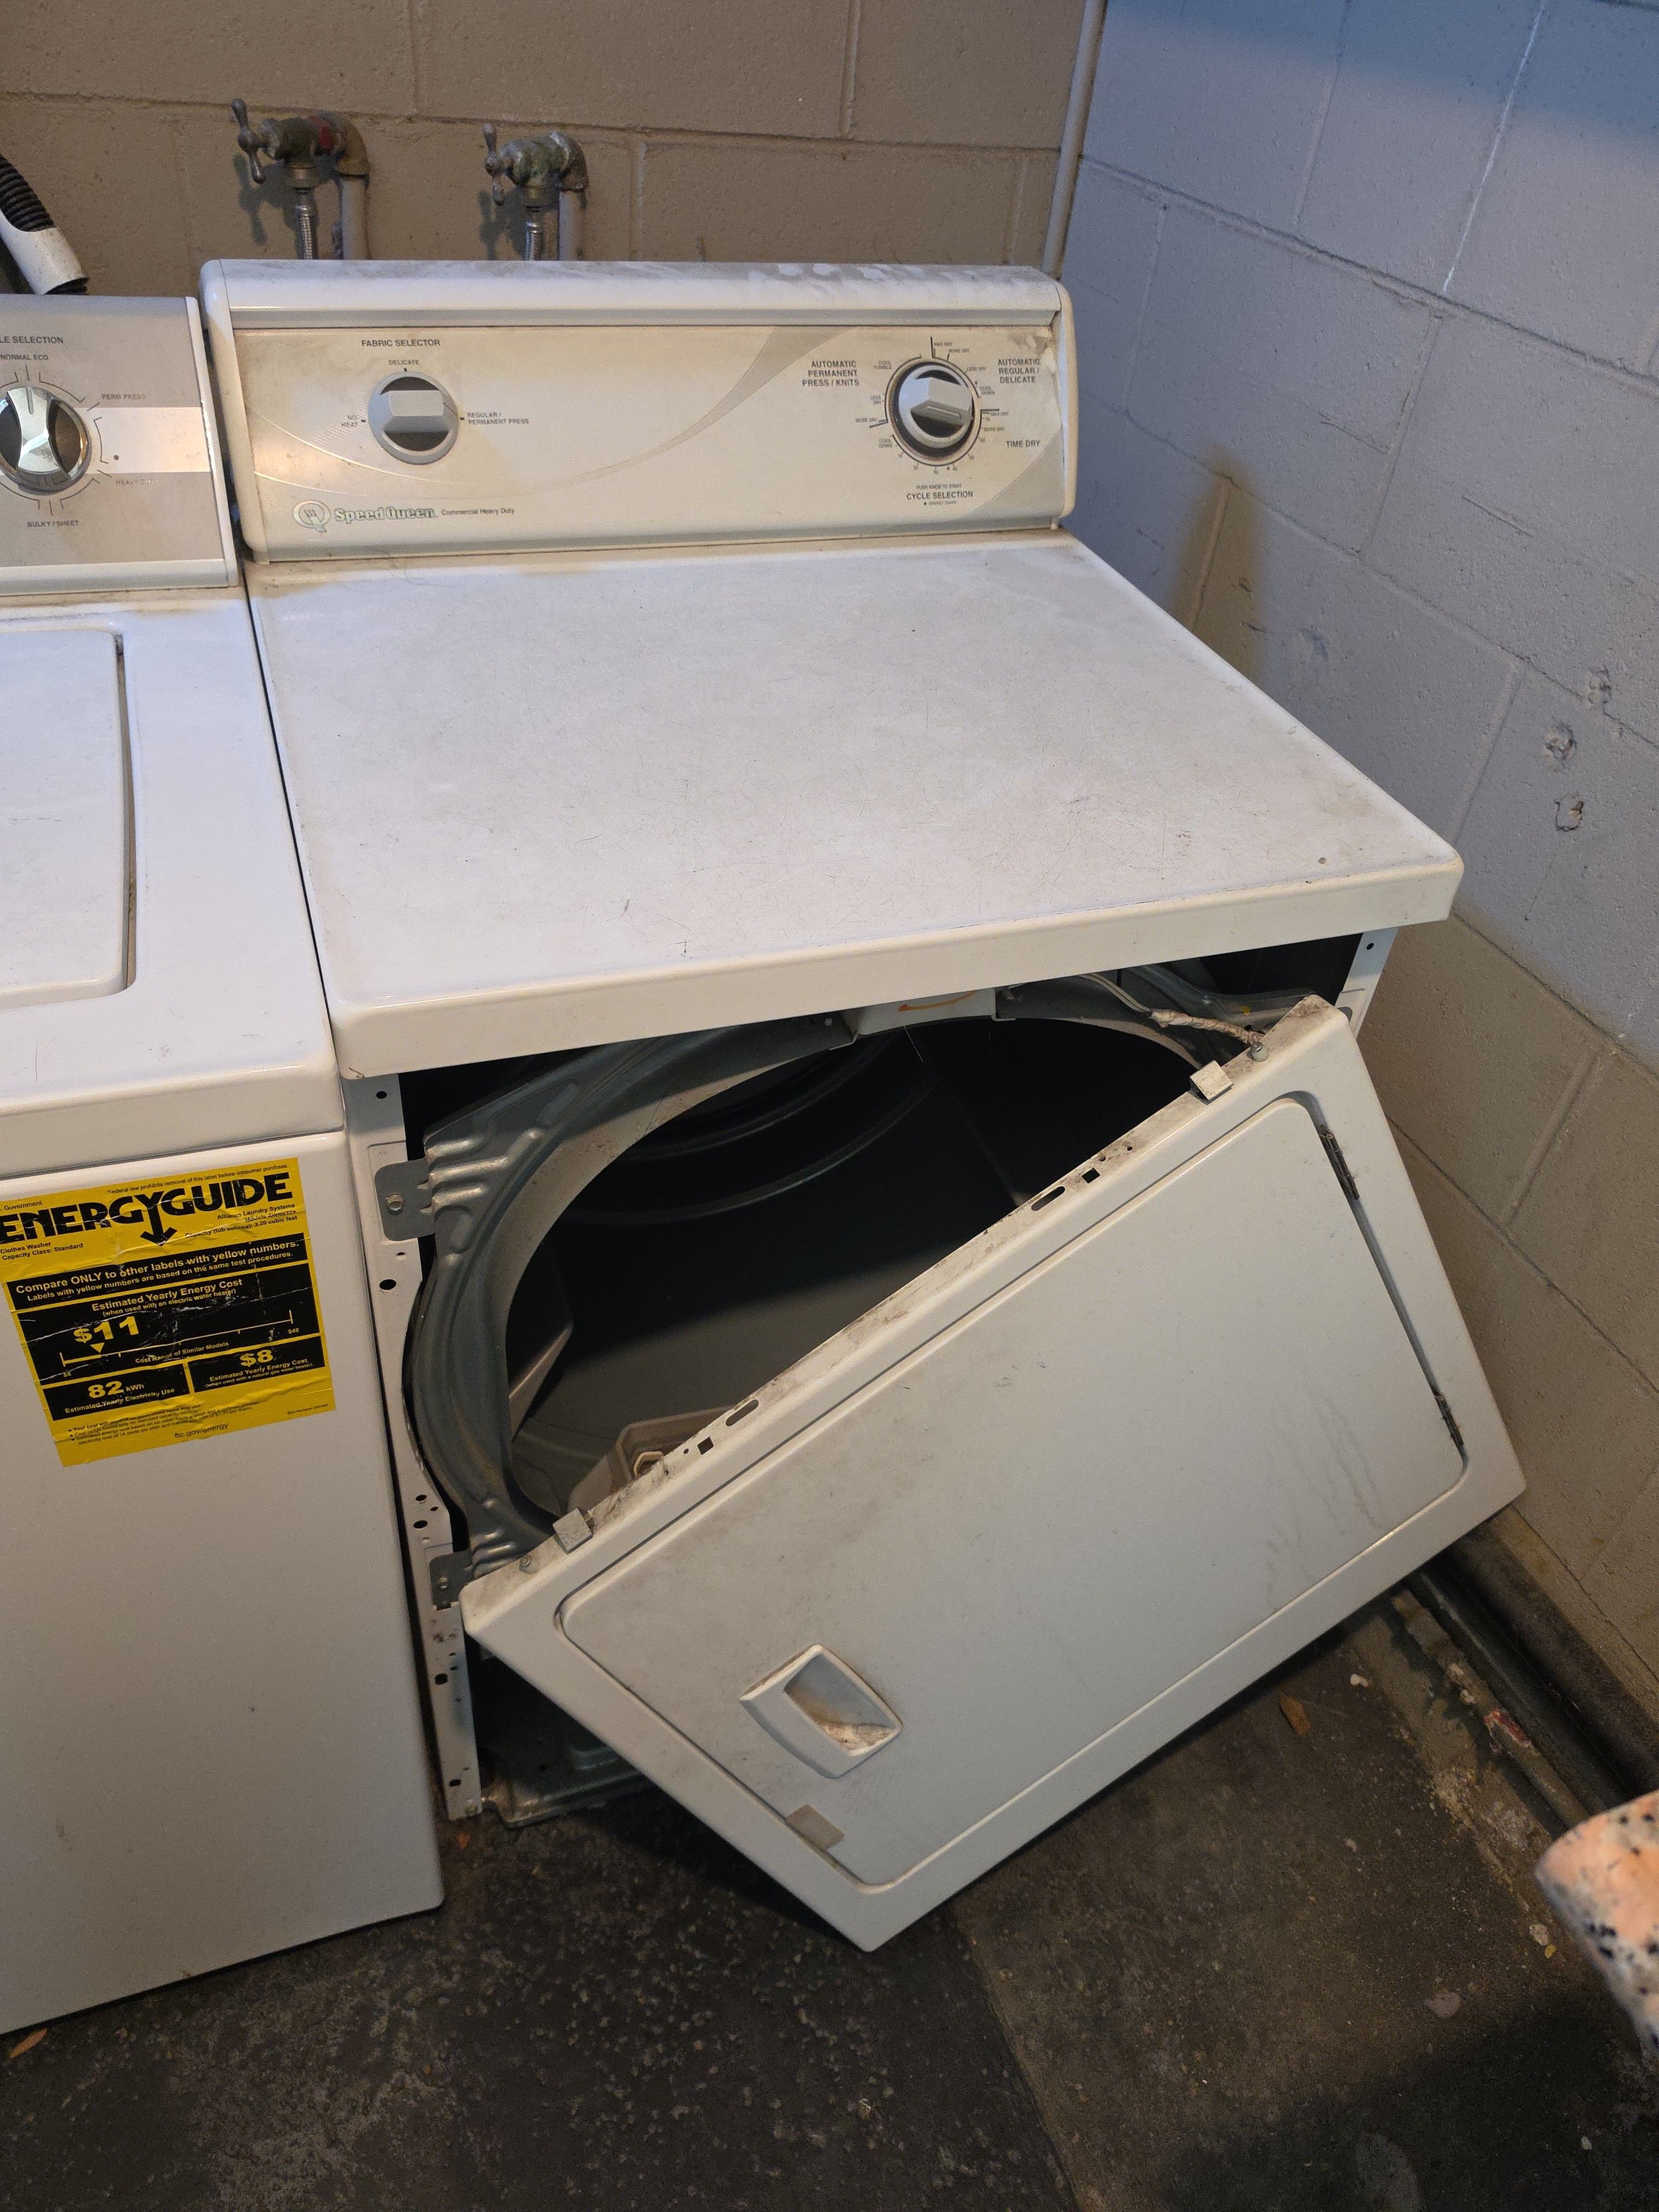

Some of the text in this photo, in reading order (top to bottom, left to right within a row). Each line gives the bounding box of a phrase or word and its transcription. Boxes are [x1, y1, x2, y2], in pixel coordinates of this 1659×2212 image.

[802, 379, 829, 387] PRESS
[1000, 376, 1036, 384] DELICATE
[933, 491, 974, 499] SELECTION
[335, 506, 437, 525] Speed Queen
[263, 1164, 288, 1172] purchase.
[4, 1201, 43, 1211] Government
[243, 1207, 268, 1216] Laundry
[269, 1204, 295, 1212] Systems
[0, 1246, 25, 1254] Clothes
[2, 1252, 30, 1261] Capacity
[54, 1243, 83, 1252] Standard
[16, 1241, 299, 1294] Compare ONLY to other labels with yellow numbers.
[28, 1292, 55, 1301] Labels
[56, 1288, 74, 1296] with
[76, 1284, 102, 1295] yellow
[105, 1278, 139, 1289] numbers
[156, 1270, 180, 1279] based
[248, 1251, 293, 1264] procedures.
[92, 1278, 243, 1311] Estimated Yearly Energy Cost
[102, 1309, 123, 1317] (when
[74, 1316, 139, 1343] $11
[182, 1346, 205, 1354] Similar
[206, 1341, 229, 1350] Models
[240, 1349, 273, 1367] $8
[209, 1371, 244, 1382] Estimated
[245, 1366, 266, 1376] Yearly
[267, 1362, 291, 1372] Energy
[88, 1381, 144, 1399] 82 kWh
[65, 1404, 100, 1413] Estimated
[125, 1390, 159, 1401] Electricity
[175, 1423, 228, 1438] ftc.gov/energy
